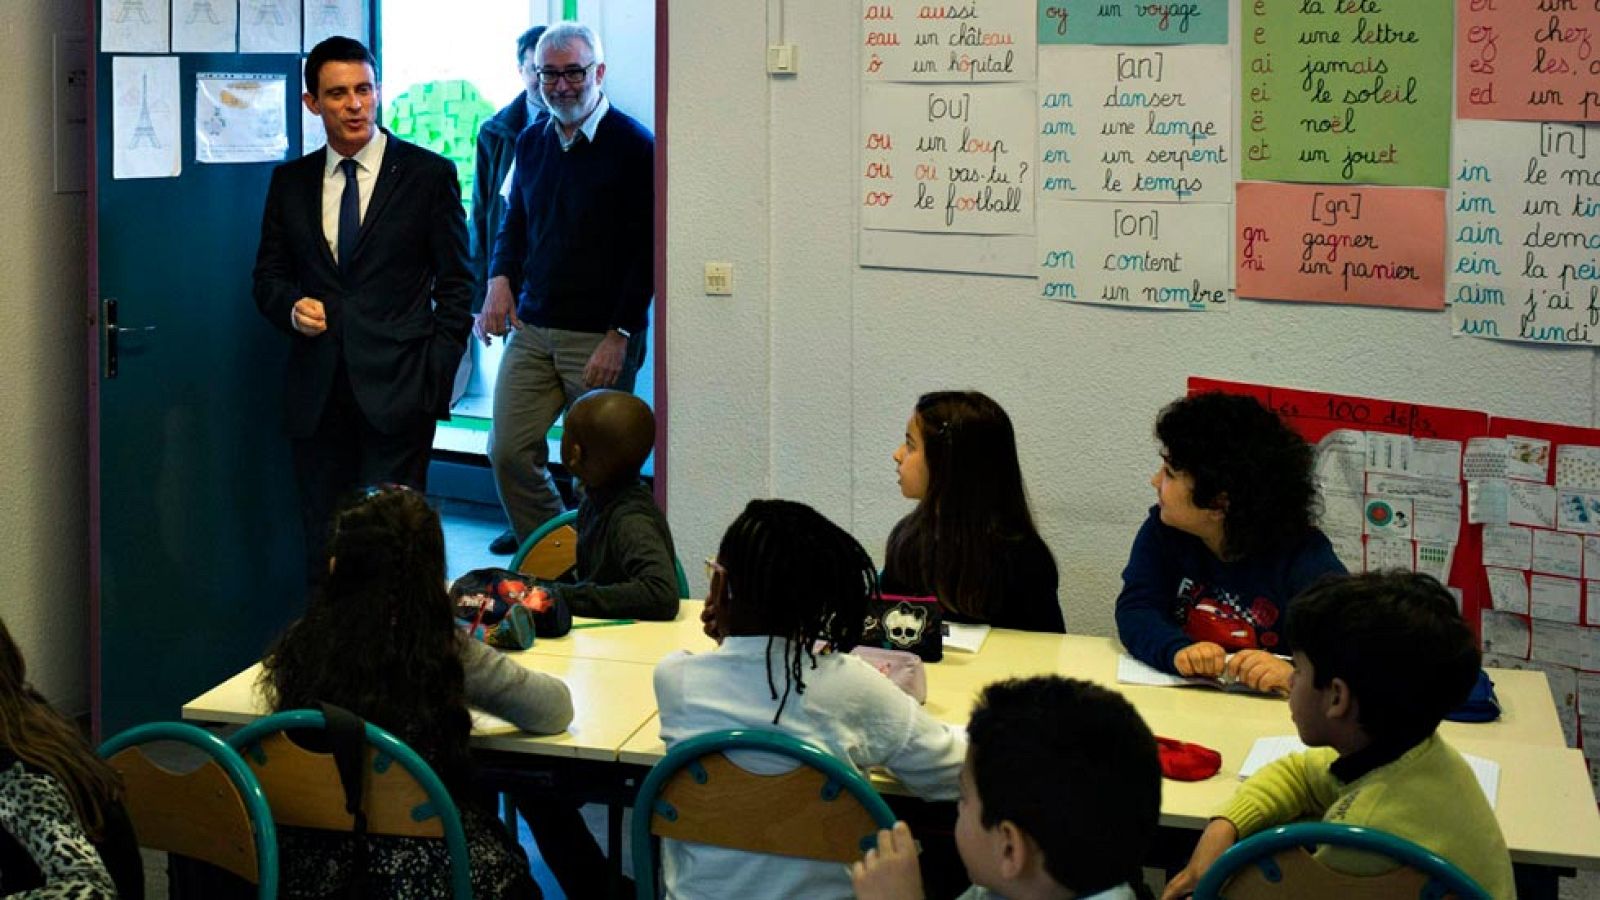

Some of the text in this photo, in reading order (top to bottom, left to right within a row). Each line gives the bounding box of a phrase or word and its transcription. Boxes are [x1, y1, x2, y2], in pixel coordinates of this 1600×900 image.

[864, 0, 979, 19] au aussi
[1046, 3, 1202, 35] oy un voyage
[864, 22, 1015, 47] eau un château
[1254, 17, 1419, 44] e une lettre
[1468, 15, 1592, 62] ez chez
[913, 58, 937, 73] un
[948, 50, 1015, 80] hôpital
[1117, 52, 1163, 82] [an]
[1251, 53, 1388, 91] ai jamais
[1469, 59, 1494, 74] es
[1042, 85, 1186, 108] an danser
[1251, 75, 1417, 103] ei le soleil
[1469, 82, 1497, 104] ed
[1528, 91, 1564, 104] un
[1042, 111, 1217, 145] am une lampe
[1251, 108, 1355, 133] ë noël
[865, 127, 1008, 162] ou un loup
[1541, 123, 1585, 158] [in]
[1042, 145, 1228, 171] en un serpent
[1249, 138, 1398, 180] et un jouet
[1457, 160, 1492, 182] in
[1523, 157, 1546, 184] le
[948, 164, 1010, 183] vas-tu
[1019, 161, 1028, 183] ?
[1042, 168, 1202, 200] em le temps
[864, 183, 1021, 226] oo le football
[1312, 192, 1361, 225] [gn]
[1456, 191, 1496, 214] im
[1523, 200, 1561, 216] un
[1114, 209, 1158, 240] [on]
[1456, 221, 1502, 245] ain
[1243, 227, 1378, 262] gn gagner
[1042, 250, 1182, 272] on content
[1241, 256, 1420, 291] ni un panier
[1455, 251, 1501, 275] ein
[1521, 251, 1548, 278] la
[1042, 279, 1226, 304] om un nombre
[1453, 283, 1505, 305] aim
[1525, 289, 1573, 322] j'ai
[1460, 315, 1592, 341] un lundi
[1328, 398, 1371, 422] 100
